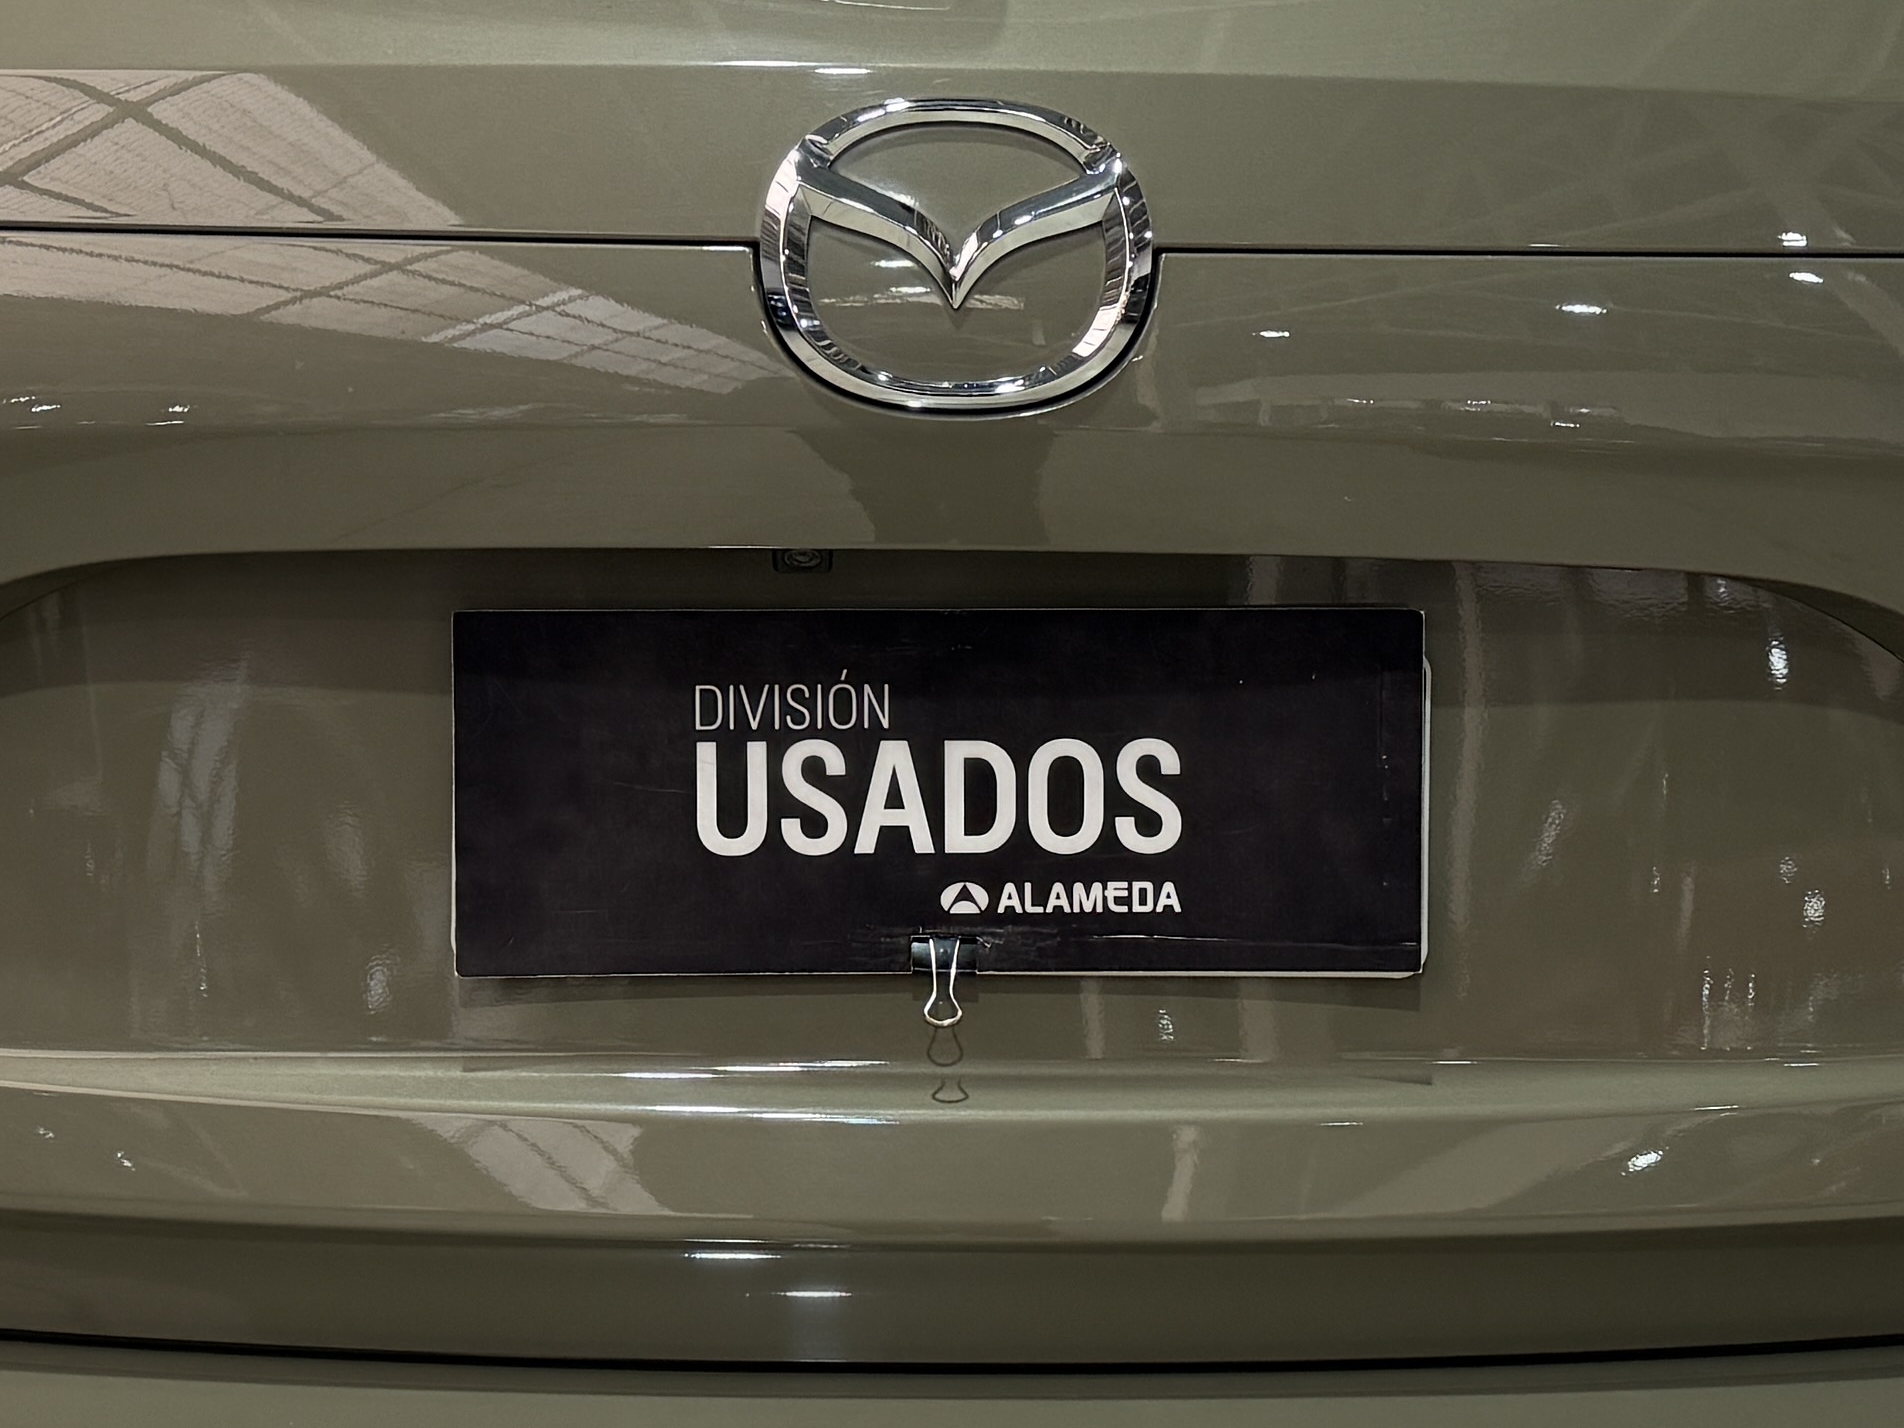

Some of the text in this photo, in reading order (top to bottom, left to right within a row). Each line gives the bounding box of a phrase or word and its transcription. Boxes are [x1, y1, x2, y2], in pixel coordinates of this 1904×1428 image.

[694, 668, 891, 732] DIVISIÓN
[695, 738, 1183, 856] USADOS
[997, 881, 1182, 914] ALAMEDA
